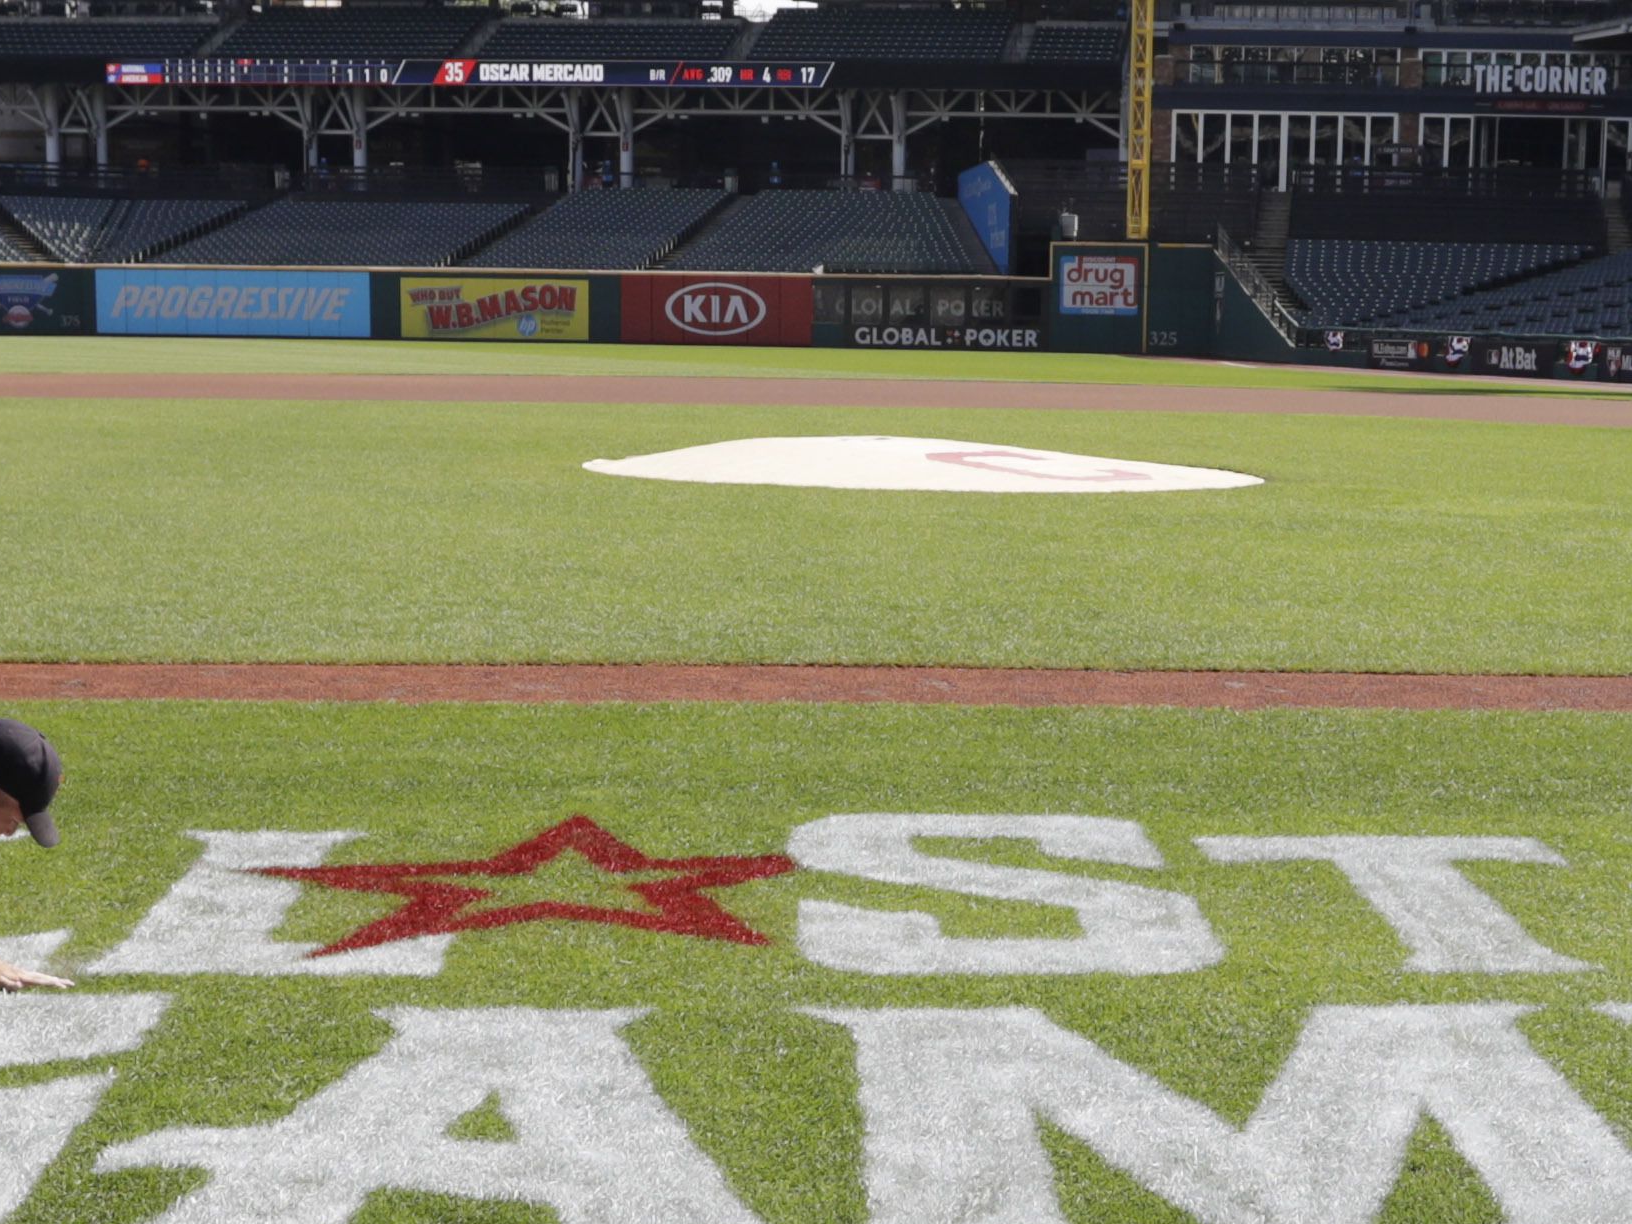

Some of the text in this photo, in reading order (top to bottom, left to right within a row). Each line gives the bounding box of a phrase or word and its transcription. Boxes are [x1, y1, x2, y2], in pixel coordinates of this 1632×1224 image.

[444, 62, 464, 82] 35
[479, 63, 529, 82] OSCAR
[533, 63, 603, 82] MERCADO
[683, 69, 704, 80] AVG
[707, 67, 732, 83] .309
[763, 67, 771, 83] 4
[801, 67, 815, 83] 17
[1474, 64, 1607, 95] THE CORNER
[1067, 256, 1125, 289] drug
[110, 285, 349, 321] PROGRESSIVE
[409, 288, 461, 302] WHO BUY
[1072, 288, 1138, 307] mart
[684, 295, 749, 323] KIA
[520, 317, 536, 335] hp
[855, 326, 1038, 347] GLOBAL POKER
[1149, 332, 1177, 346] 325
[1500, 346, 1536, 370] At Bat
